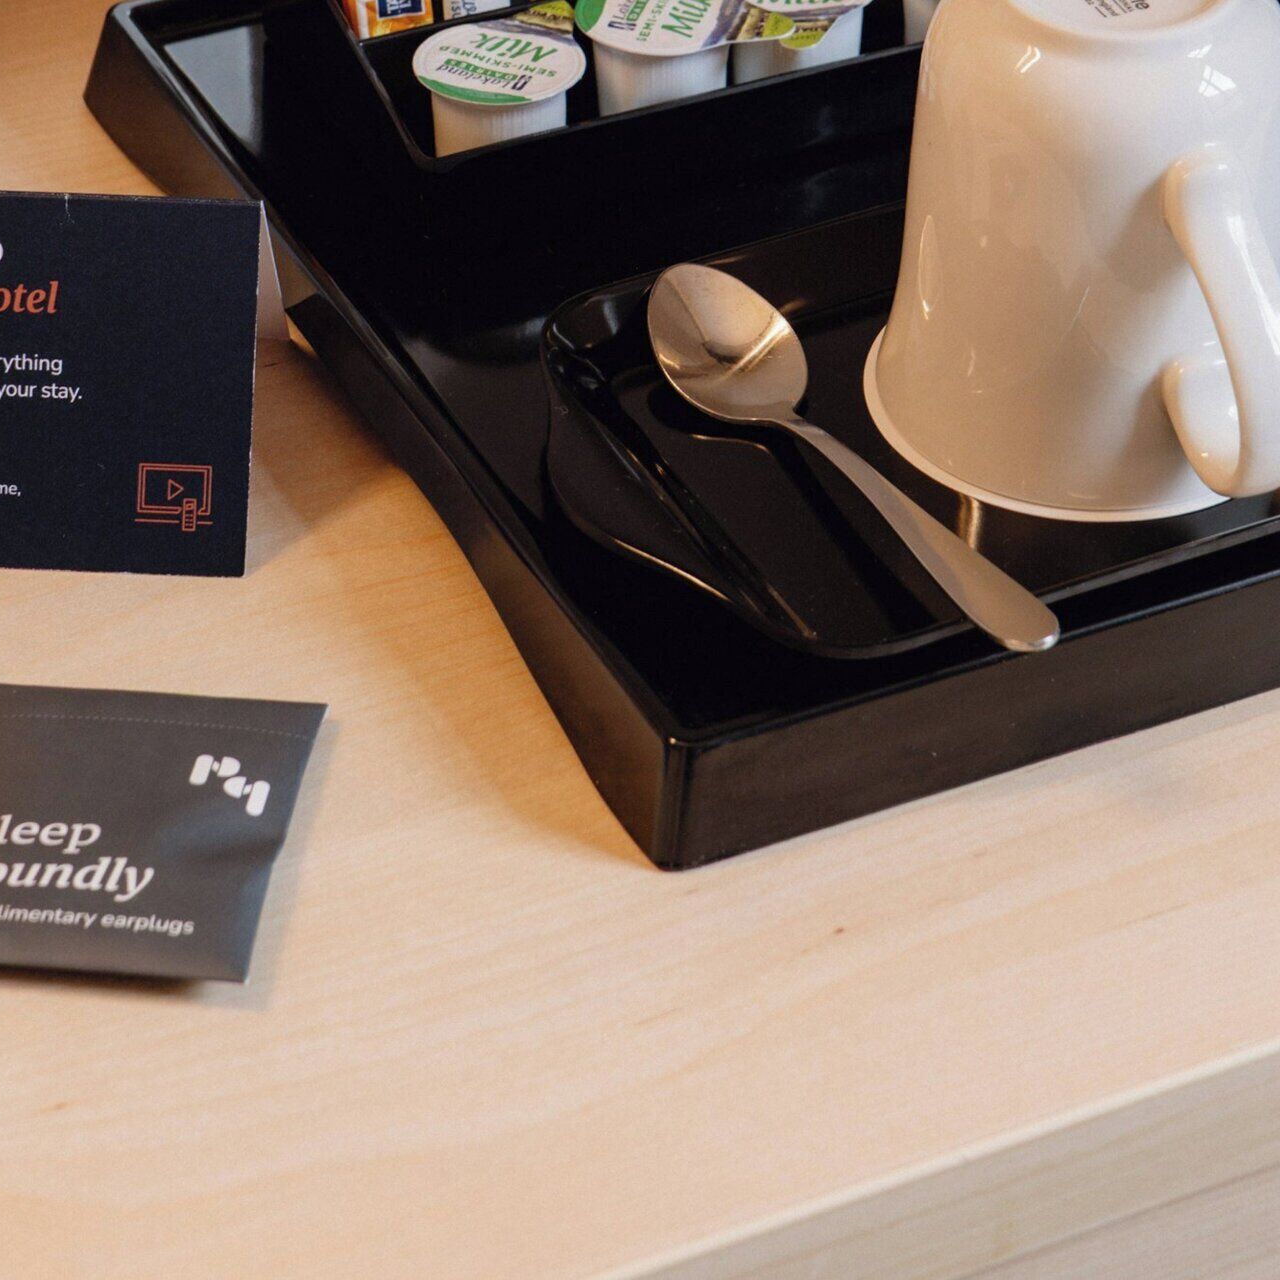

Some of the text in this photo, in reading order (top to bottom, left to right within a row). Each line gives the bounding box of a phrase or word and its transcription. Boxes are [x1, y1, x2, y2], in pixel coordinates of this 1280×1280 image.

[439, 45, 557, 78] SEMI-SKIMMED
[470, 33, 558, 63] Milk
[436, 64, 508, 89] Lakeland
[41, 382, 83, 404] stay.
[99, 910, 195, 937] earplugs
